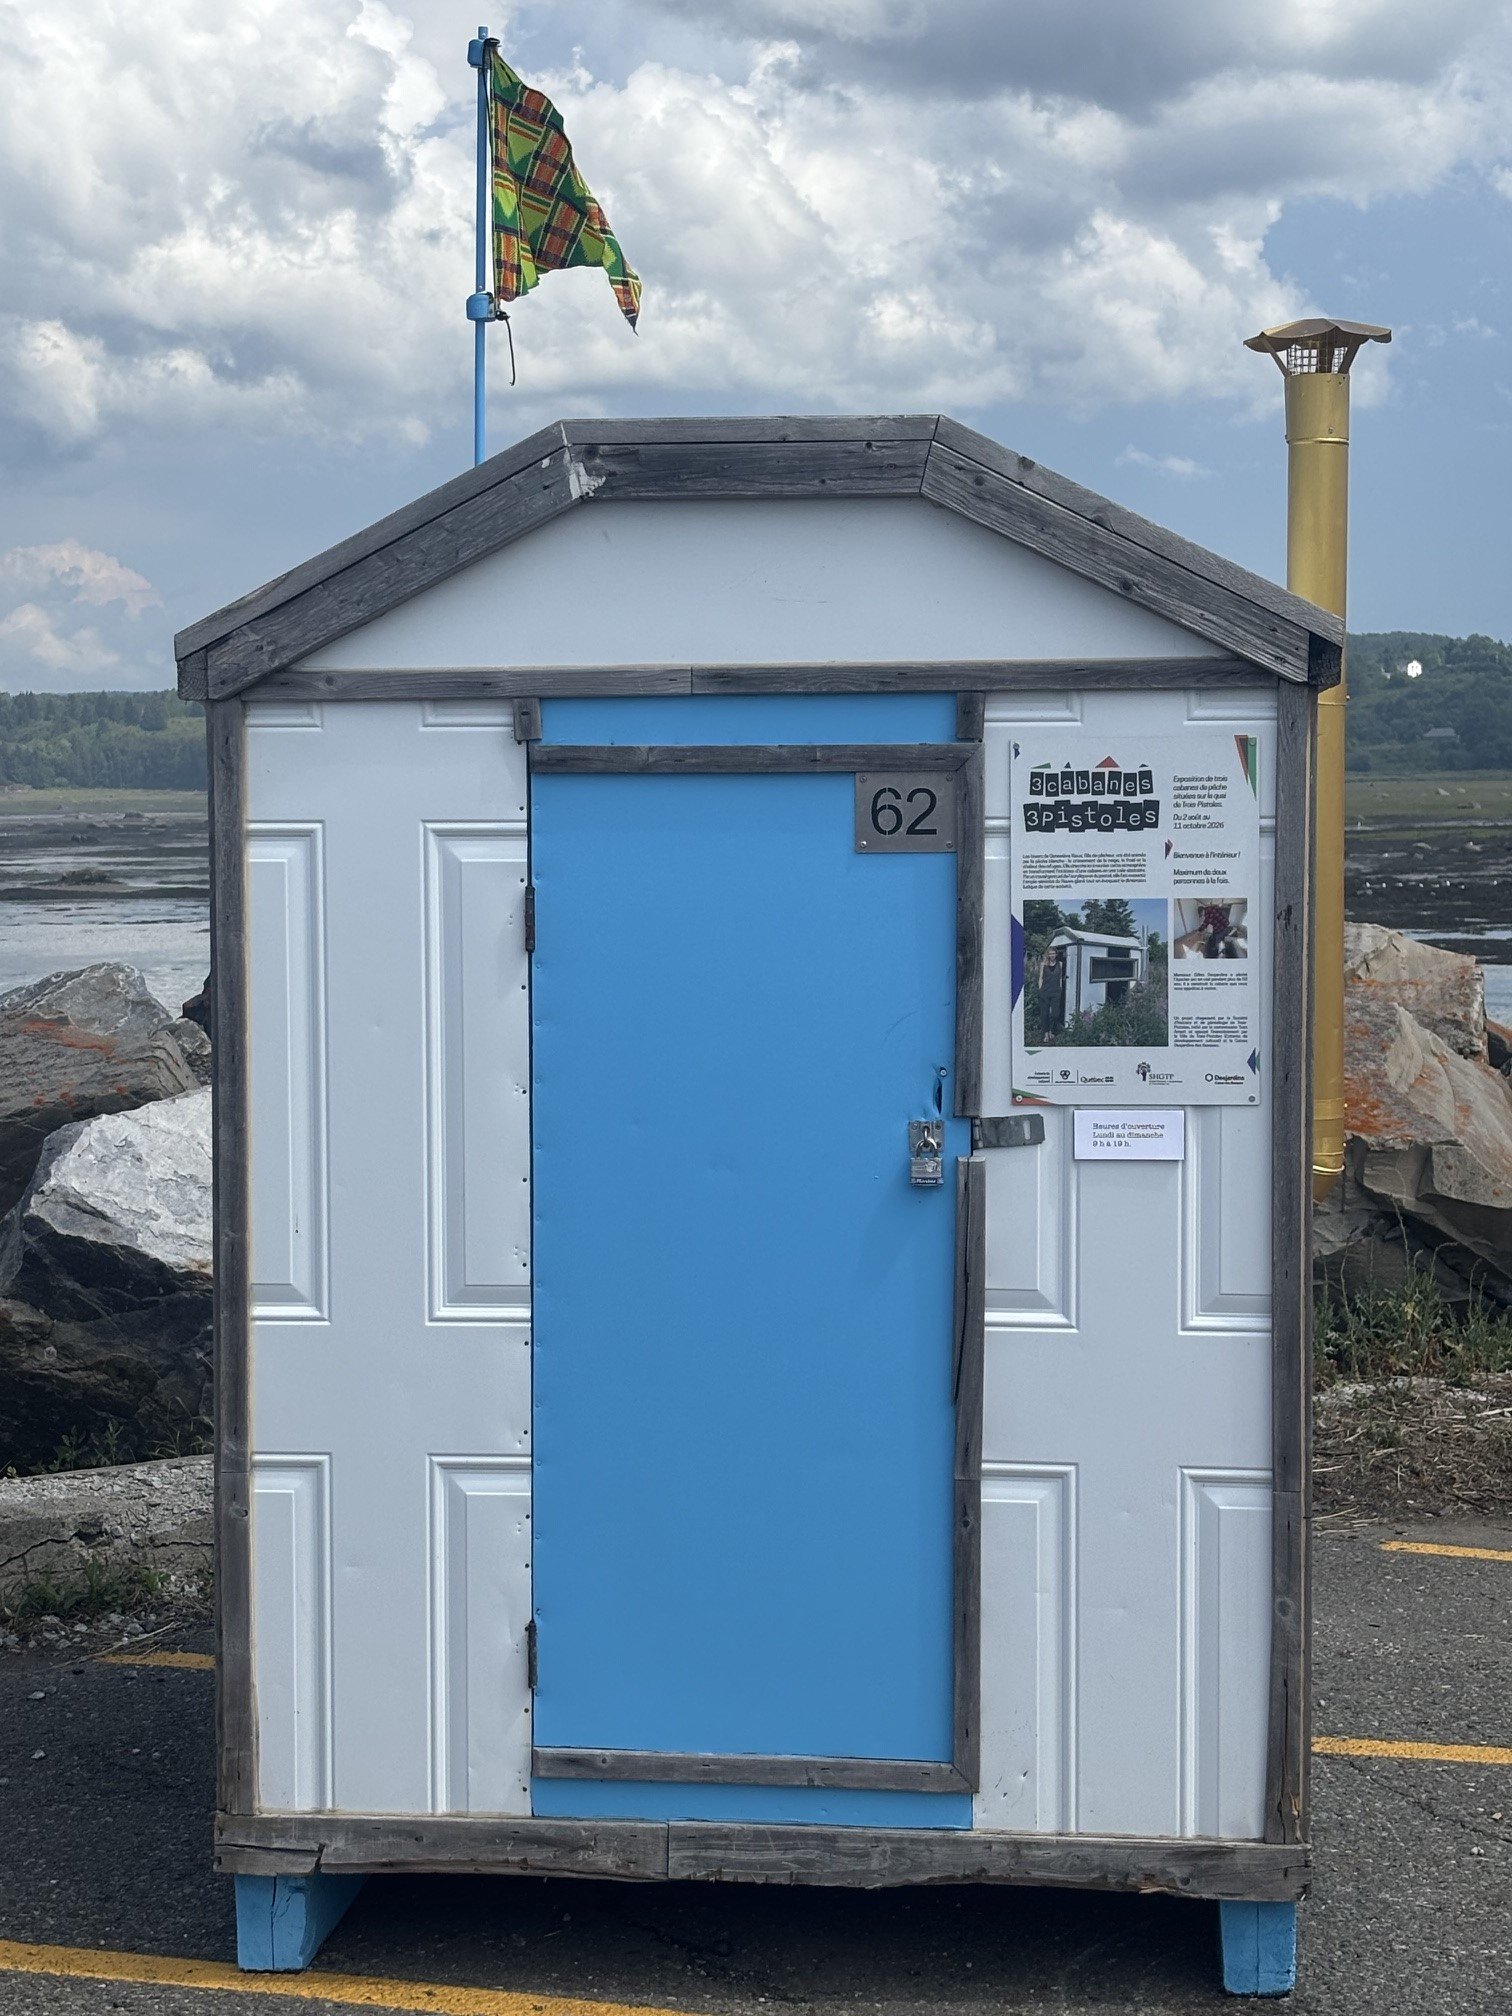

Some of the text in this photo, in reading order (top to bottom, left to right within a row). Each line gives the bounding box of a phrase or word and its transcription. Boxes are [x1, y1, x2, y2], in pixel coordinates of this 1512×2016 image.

[1173, 775, 1204, 783] Exposition
[1208, 783, 1227, 792] pêche
[1213, 792, 1226, 800] quai
[870, 786, 938, 836] 62
[1207, 821, 1224, 829] 2026
[1120, 1122, 1165, 1130] d'ouverture
